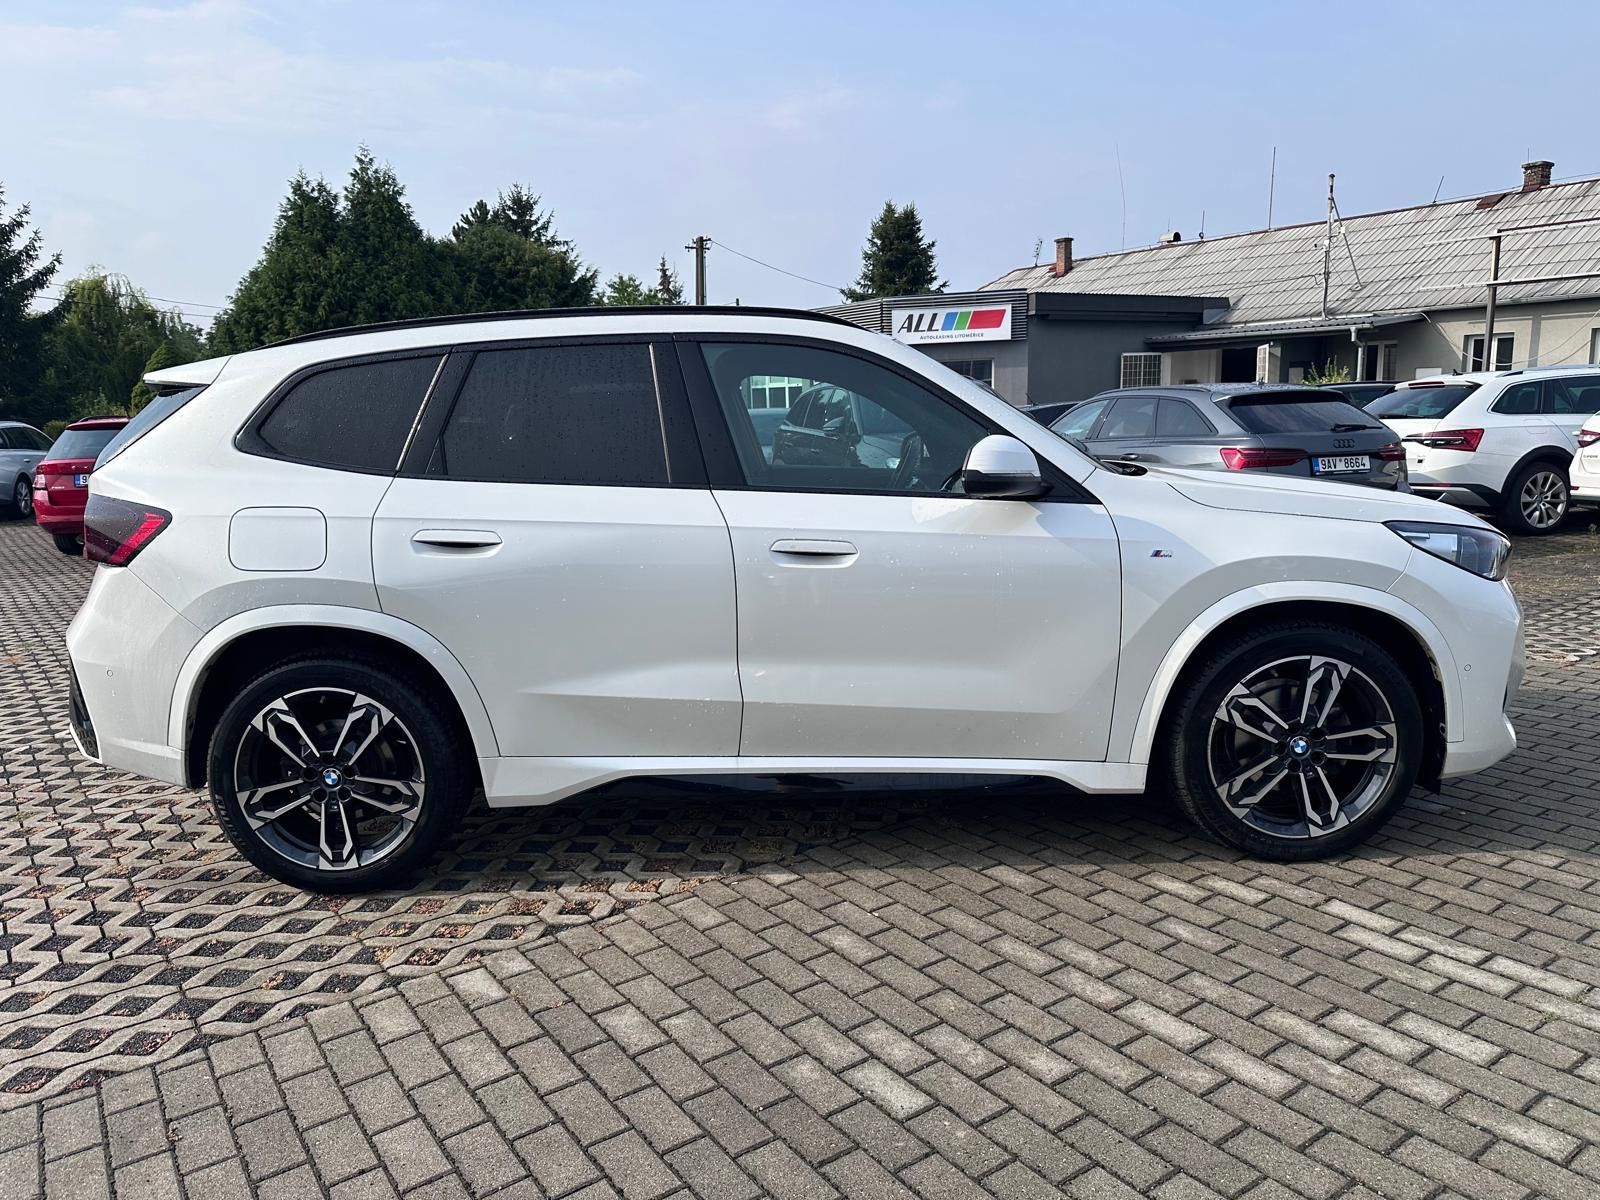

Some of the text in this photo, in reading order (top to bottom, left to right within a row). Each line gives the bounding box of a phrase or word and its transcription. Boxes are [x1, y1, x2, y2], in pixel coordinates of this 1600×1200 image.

[897, 313, 939, 333] ALL
[1321, 457, 1366, 470] 9AV 8664
